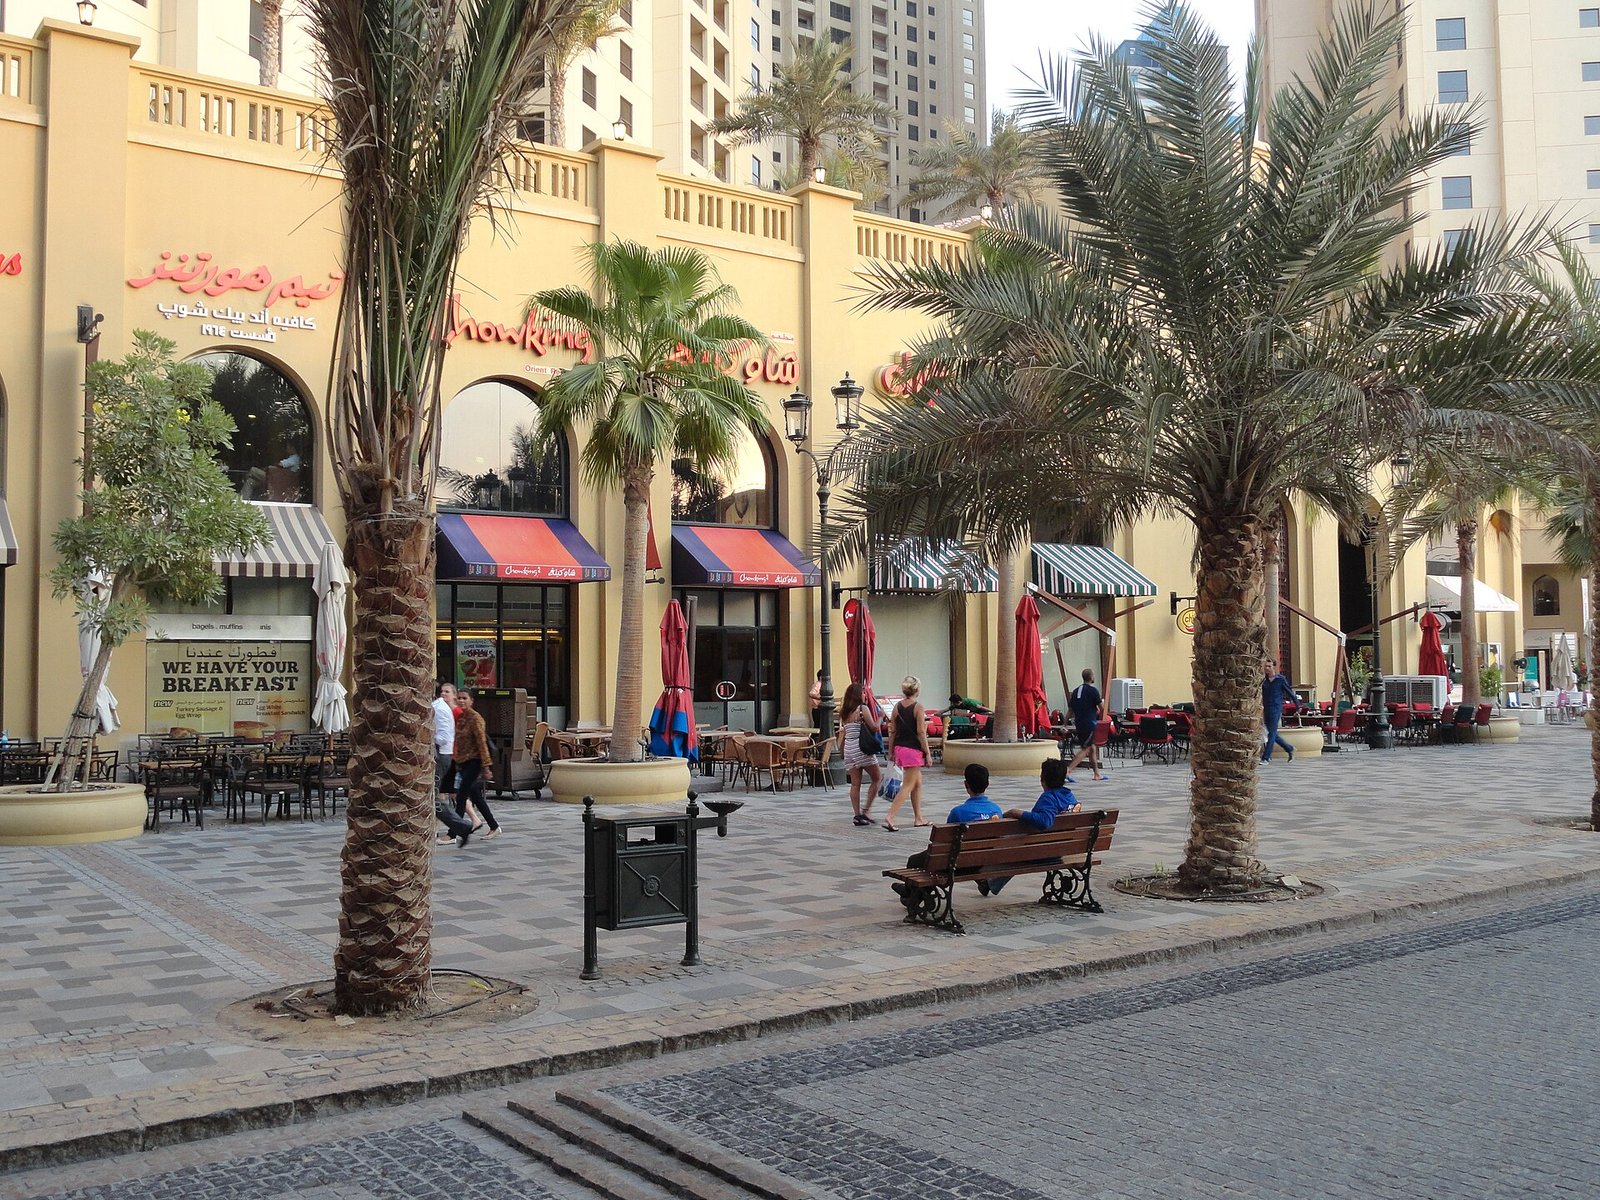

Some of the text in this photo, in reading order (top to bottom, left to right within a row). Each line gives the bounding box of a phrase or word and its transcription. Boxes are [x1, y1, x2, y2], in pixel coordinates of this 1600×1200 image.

[127, 250, 272, 297] هورتنز
[272, 315, 317, 332] كافيه
[443, 293, 593, 366] howking
[525, 364, 547, 374] Orient
[192, 623, 214, 631] bagels
[186, 645, 277, 661] فطورك عندنا
[162, 661, 299, 674] WE HAVE YOUR
[162, 676, 298, 693] BREAKFAST
[153, 699, 174, 708] new
[235, 698, 256, 706] new
